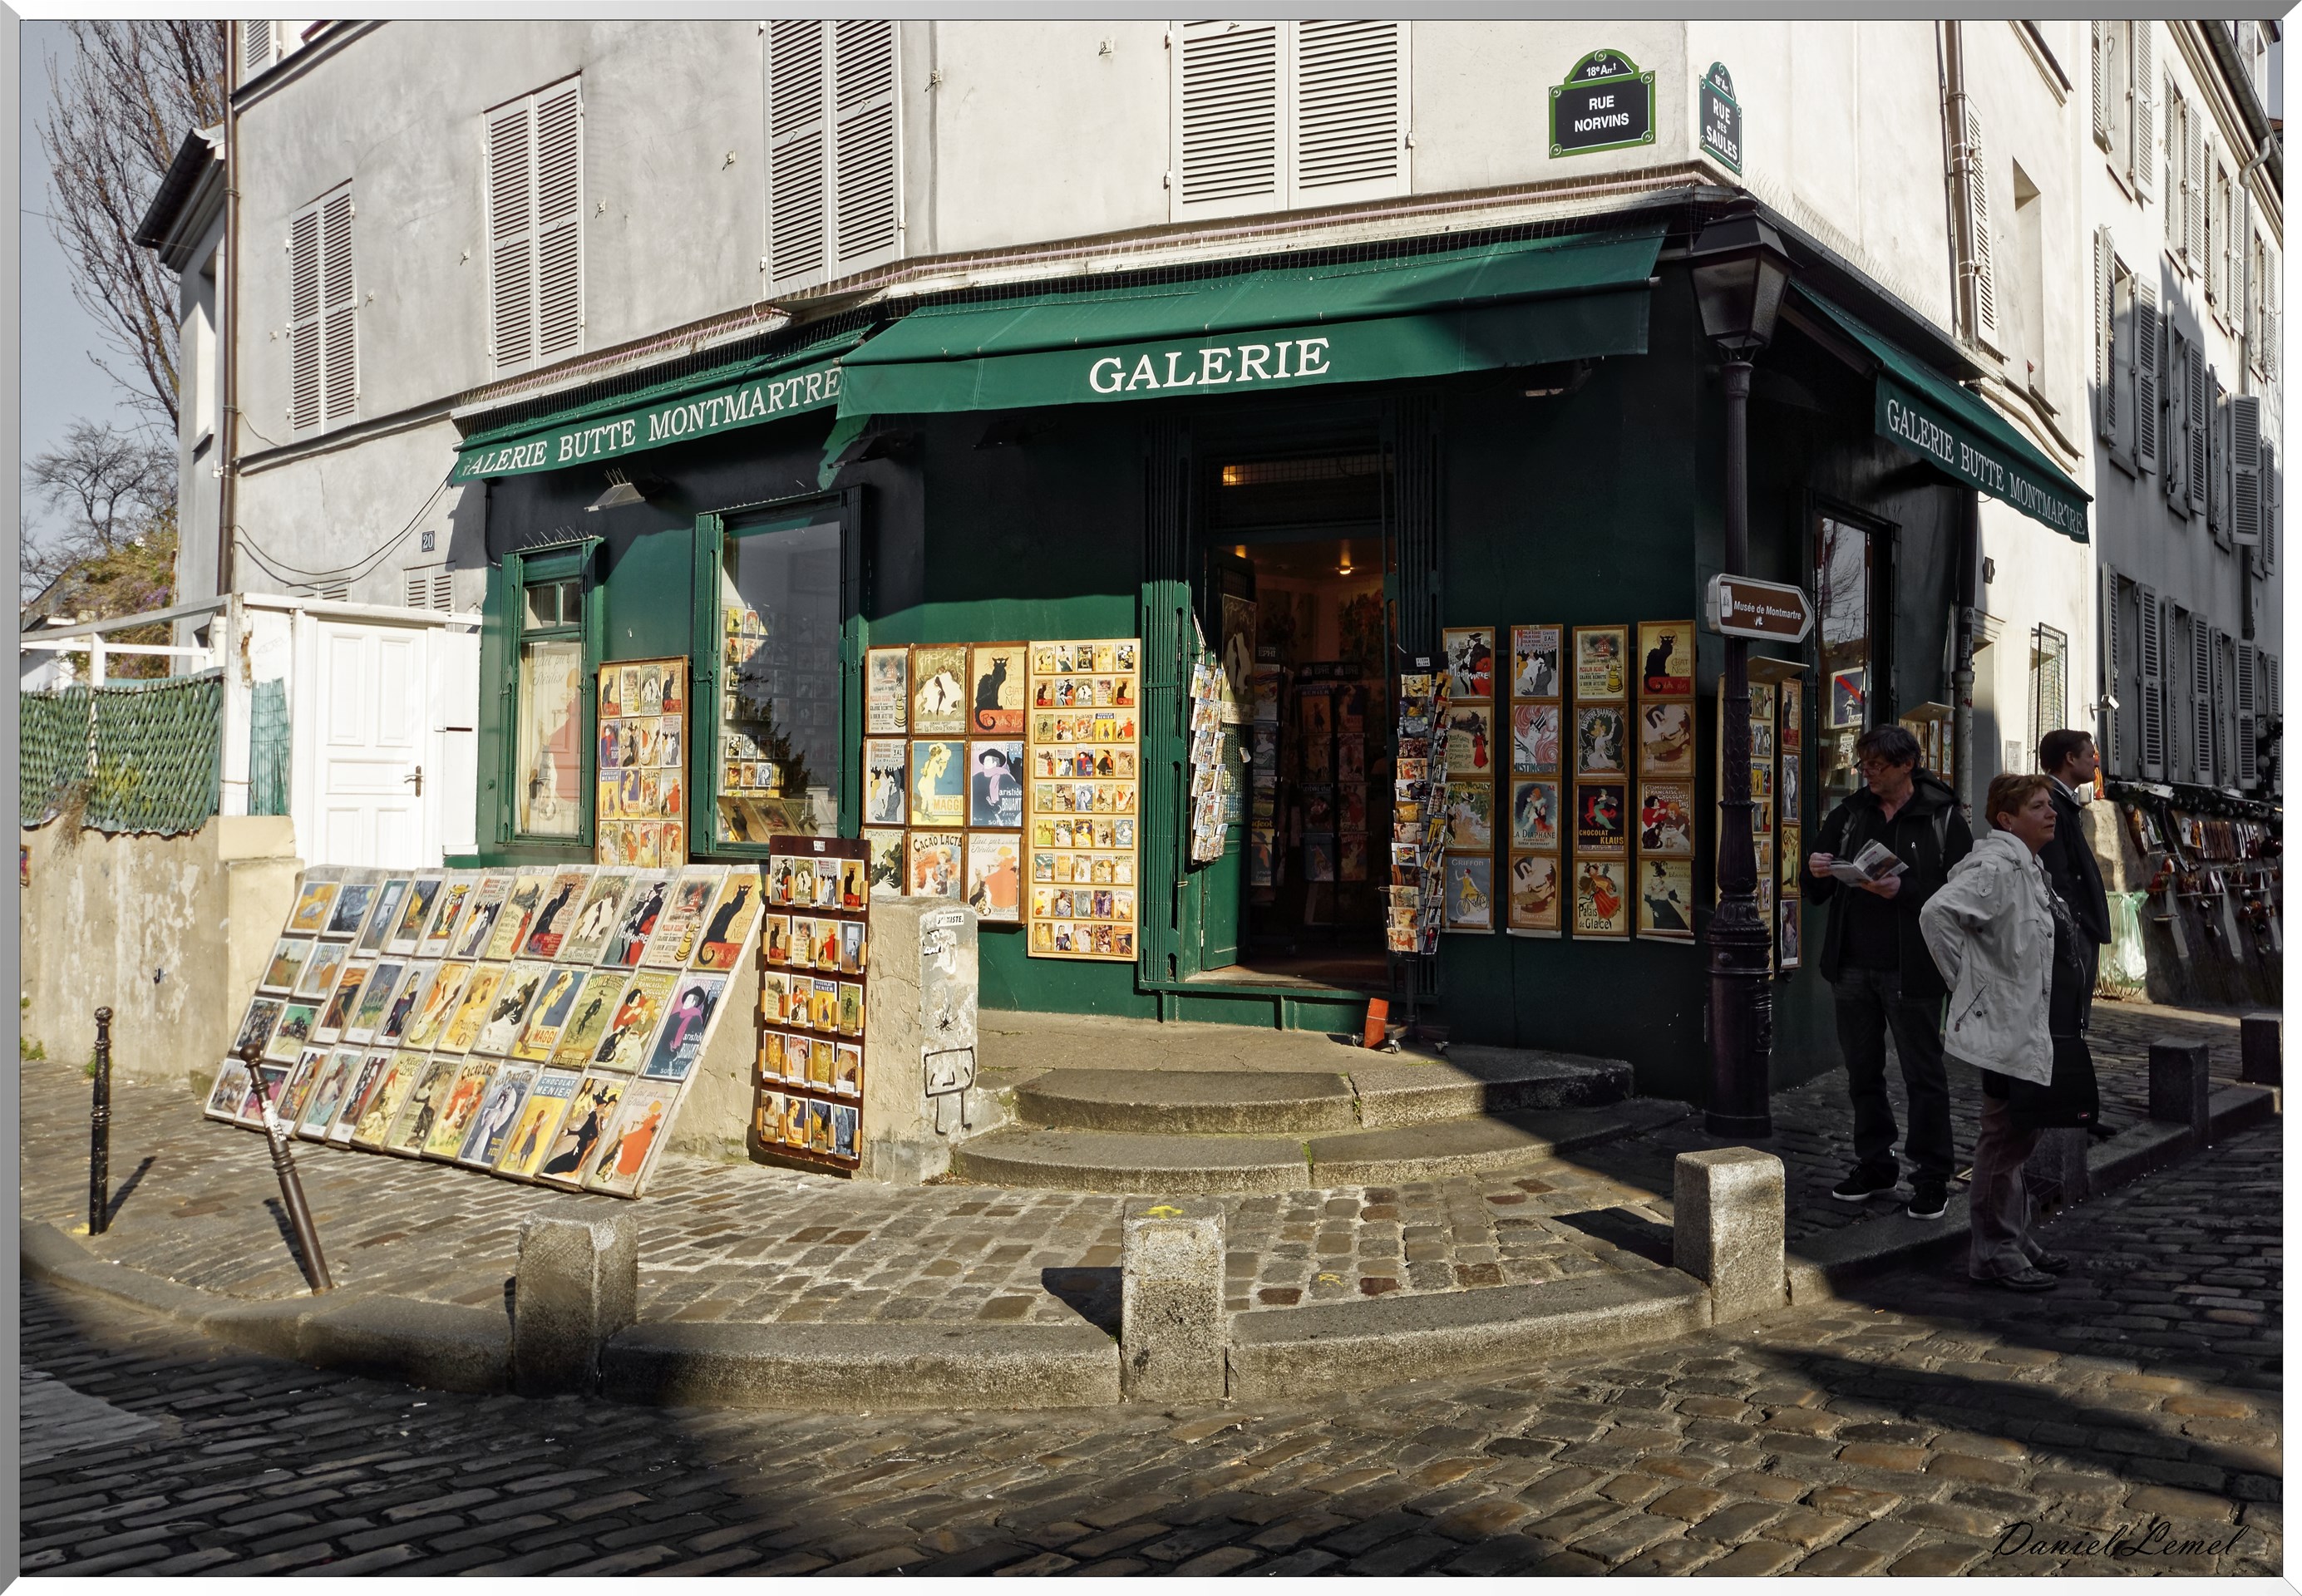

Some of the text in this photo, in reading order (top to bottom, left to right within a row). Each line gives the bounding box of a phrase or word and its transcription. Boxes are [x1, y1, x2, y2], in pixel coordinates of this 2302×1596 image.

[1589, 95, 1614, 111] RUE
[1713, 97, 1730, 125] RUE
[1575, 112, 1629, 132] NORVINS
[1717, 121, 1727, 134] DES
[1706, 126, 1738, 160] SAULES
[1089, 337, 1330, 393] GALERIE
[558, 419, 637, 462] BUTTE
[648, 366, 841, 441] MONTMARTRE
[1886, 398, 2086, 536] GALERIE BUTTE MONTMARTRE
[422, 533, 434, 549] 20
[1733, 600, 1802, 620] Musée de Montmartre
[998, 787, 1022, 796] aristide
[934, 800, 962, 810] MAGGI
[1001, 798, 1022, 811] BRUANT
[971, 835, 986, 845] Lait
[1522, 830, 1555, 840] DIAPHANE
[1600, 836, 1624, 845] KLAUS
[913, 835, 938, 852] CACAO
[1452, 858, 1484, 866] GRIFFON
[1578, 904, 1598, 918] Palais
[589, 975, 610, 990] HOWE
[535, 1030, 557, 1043] MAGGI
[461, 1065, 481, 1081] CACAO
[541, 1077, 575, 1086] CHOCOLAT
[535, 1086, 572, 1097] MENIER
